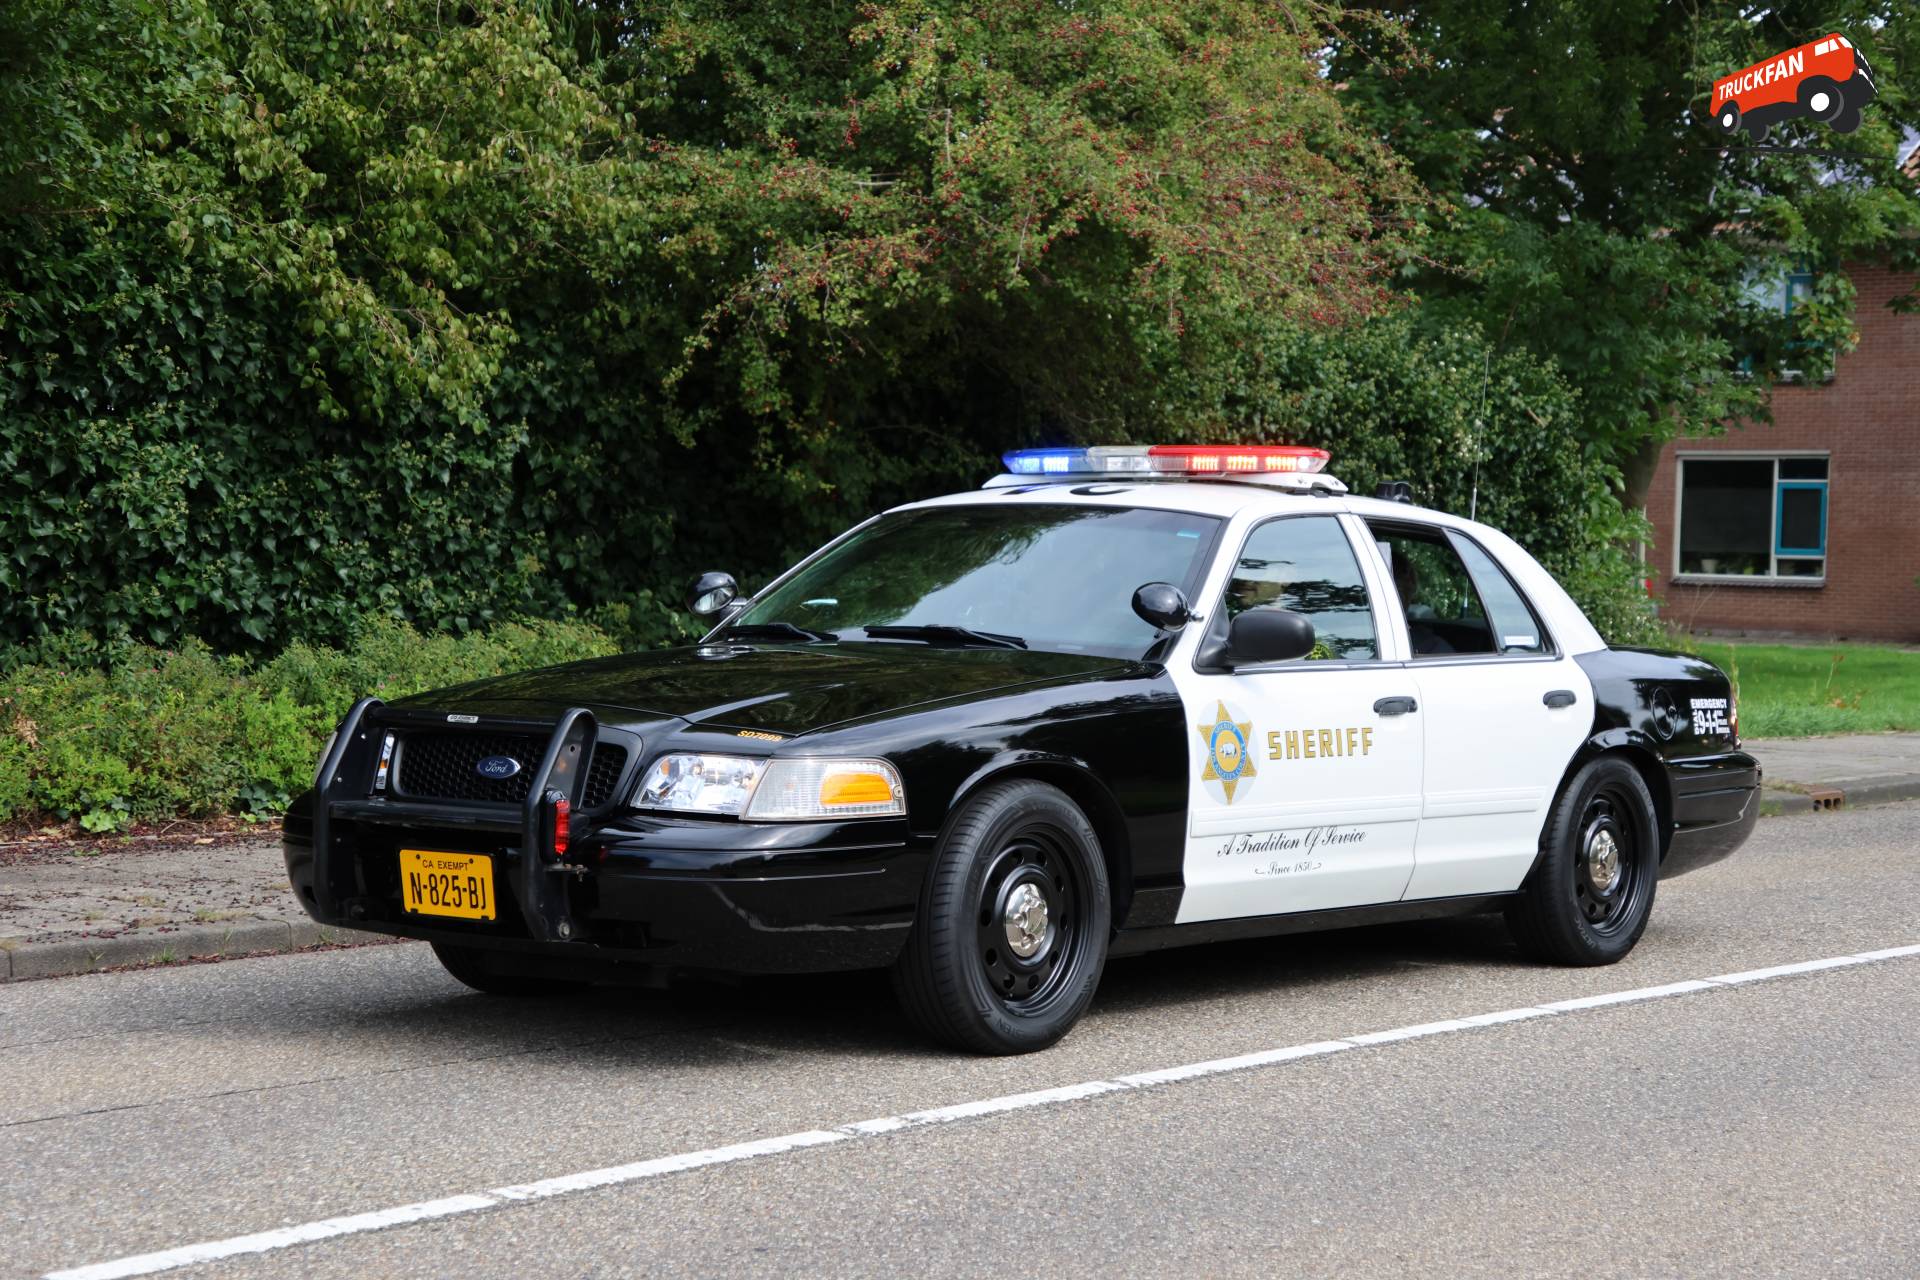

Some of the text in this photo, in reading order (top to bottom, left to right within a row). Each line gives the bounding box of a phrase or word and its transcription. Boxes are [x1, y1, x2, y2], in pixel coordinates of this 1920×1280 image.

[1690, 698, 1728, 709] EMERGENCY
[1267, 727, 1374, 760] SHERIFF
[485, 760, 509, 773] Ford
[1217, 824, 1367, 857] A Tradition Of Service
[422, 859, 469, 871] CA EXEMPT
[1267, 860, 1313, 876] Since 1850
[410, 871, 487, 910] N-825-BJ
